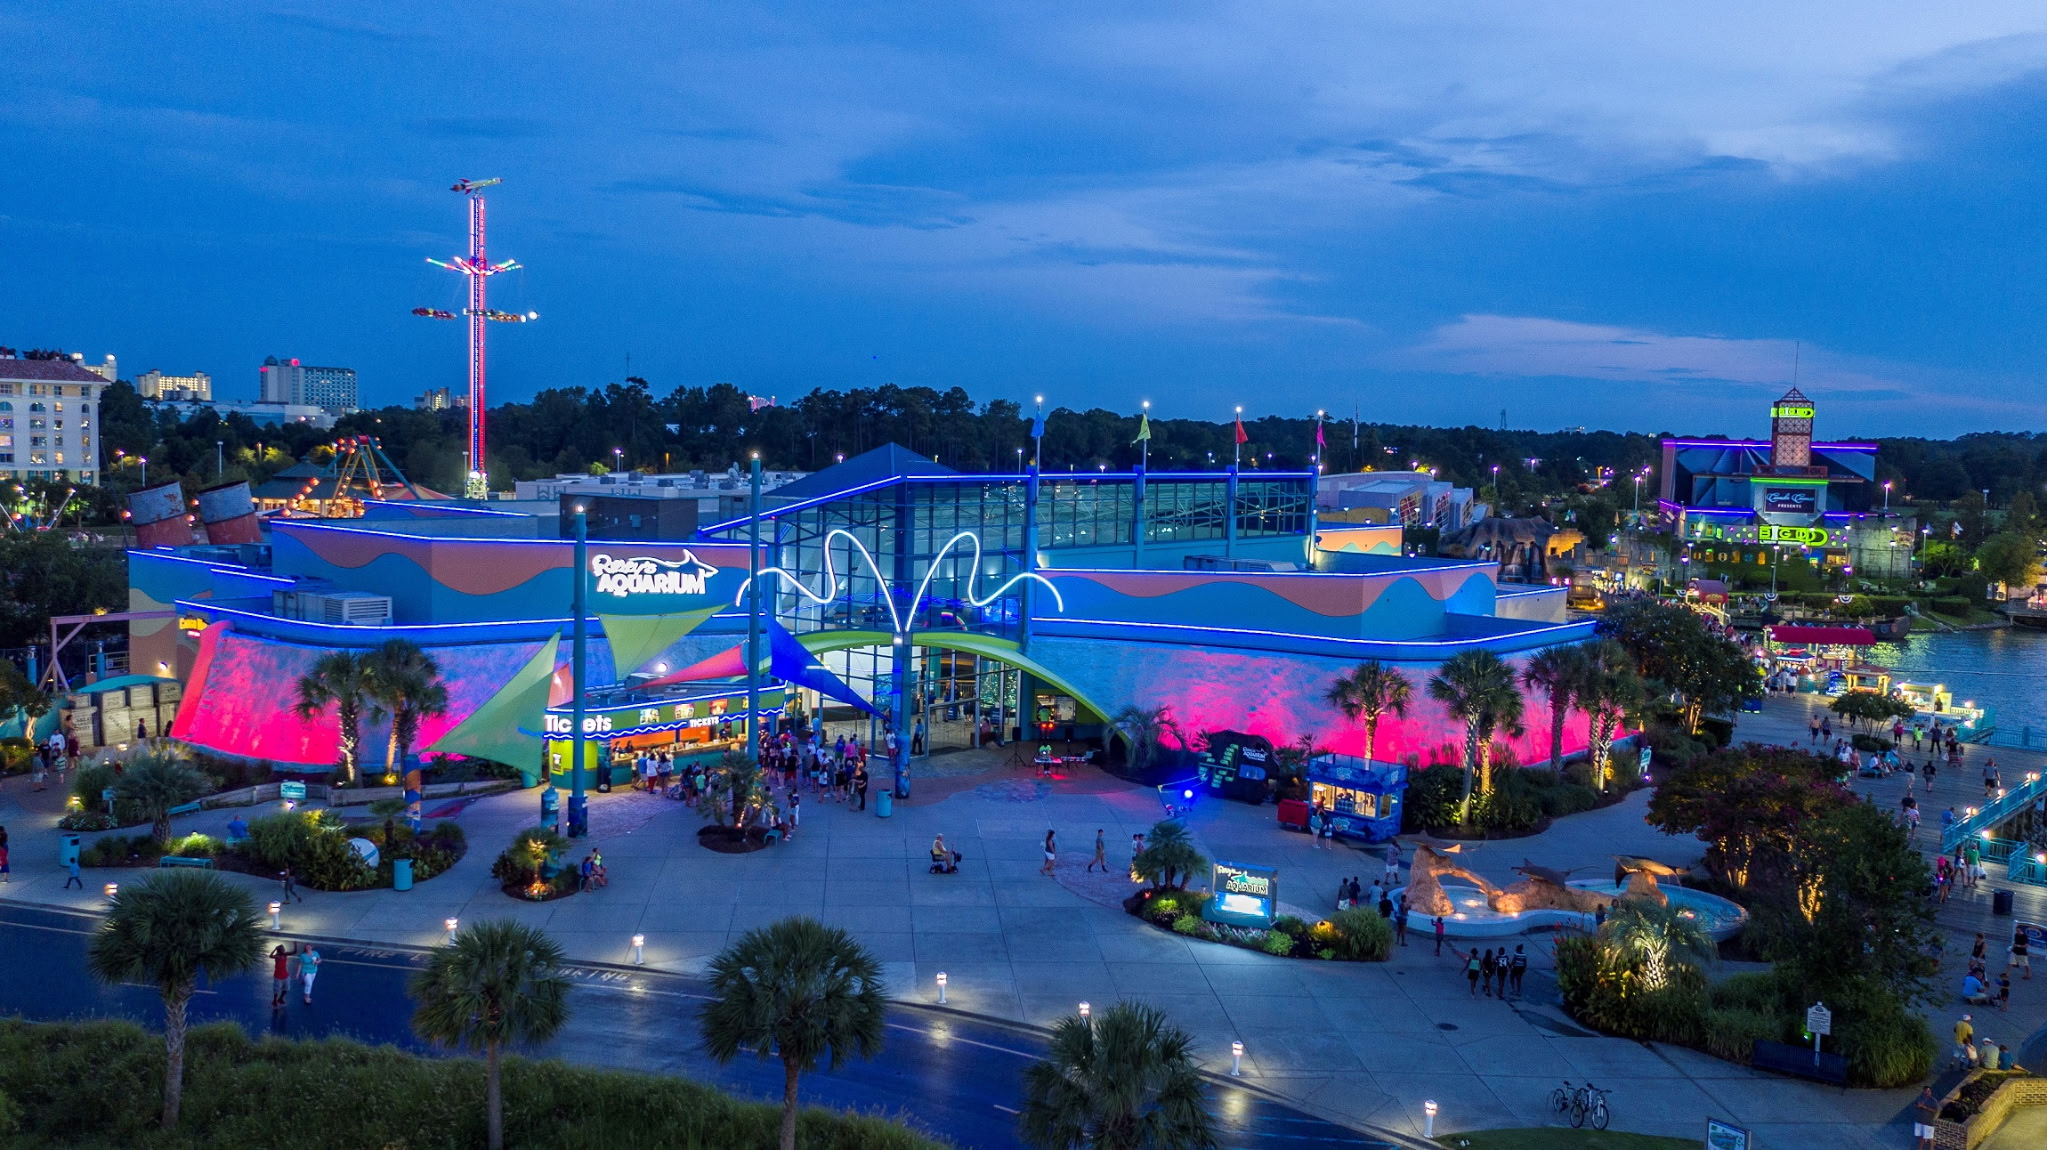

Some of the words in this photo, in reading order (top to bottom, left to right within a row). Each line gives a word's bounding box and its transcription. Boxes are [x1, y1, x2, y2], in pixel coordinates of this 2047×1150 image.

[597, 568, 706, 597] AQUARIUM
[544, 714, 613, 733] Ticets
[689, 716, 720, 728] TICKETS
[1226, 880, 1269, 895] AQUARIUM
